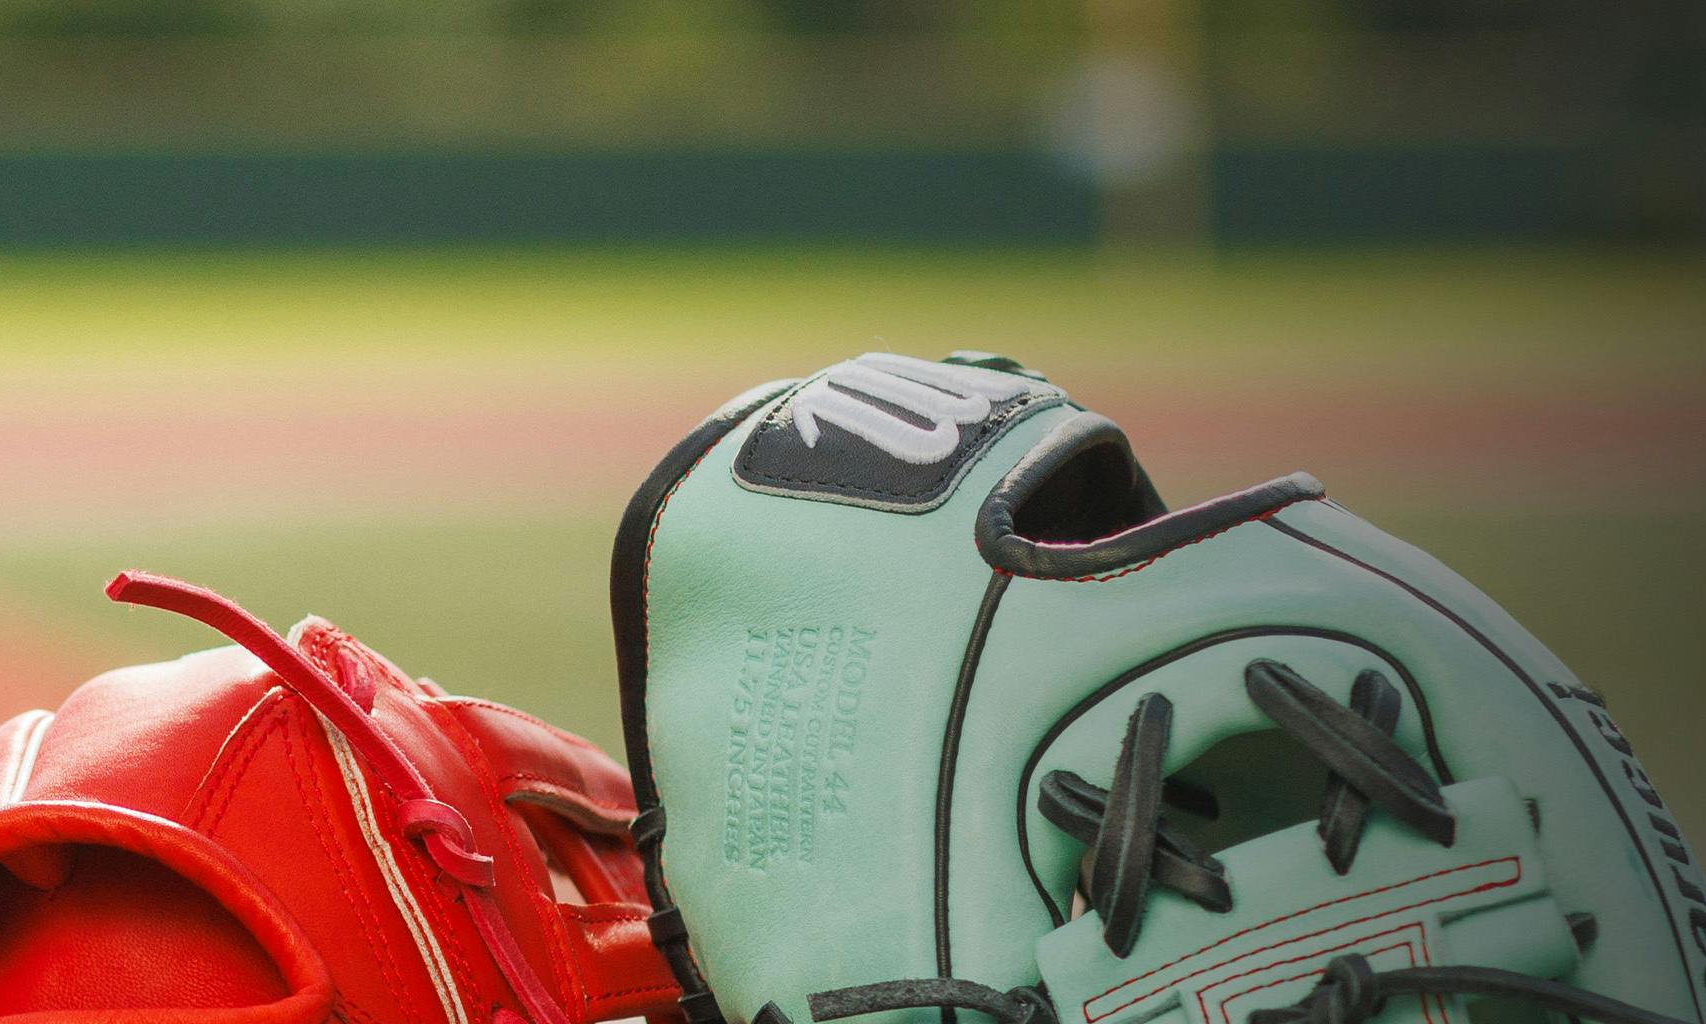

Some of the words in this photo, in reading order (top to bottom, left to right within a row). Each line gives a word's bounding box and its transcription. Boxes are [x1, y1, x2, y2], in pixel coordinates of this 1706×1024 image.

[734, 629, 768, 714] 11.75
[759, 628, 794, 737] TANNED
[789, 627, 820, 689] USA
[814, 627, 843, 712] CUSTOM
[829, 627, 878, 760] MODEL
[751, 745, 769, 773] IN
[771, 703, 801, 856] LEATHER
[801, 719, 822, 769] CUT
[724, 728, 748, 863] INCHES
[748, 773, 766, 871] JAPAN
[800, 768, 816, 865] PATTERN
[822, 771, 850, 814] 44
